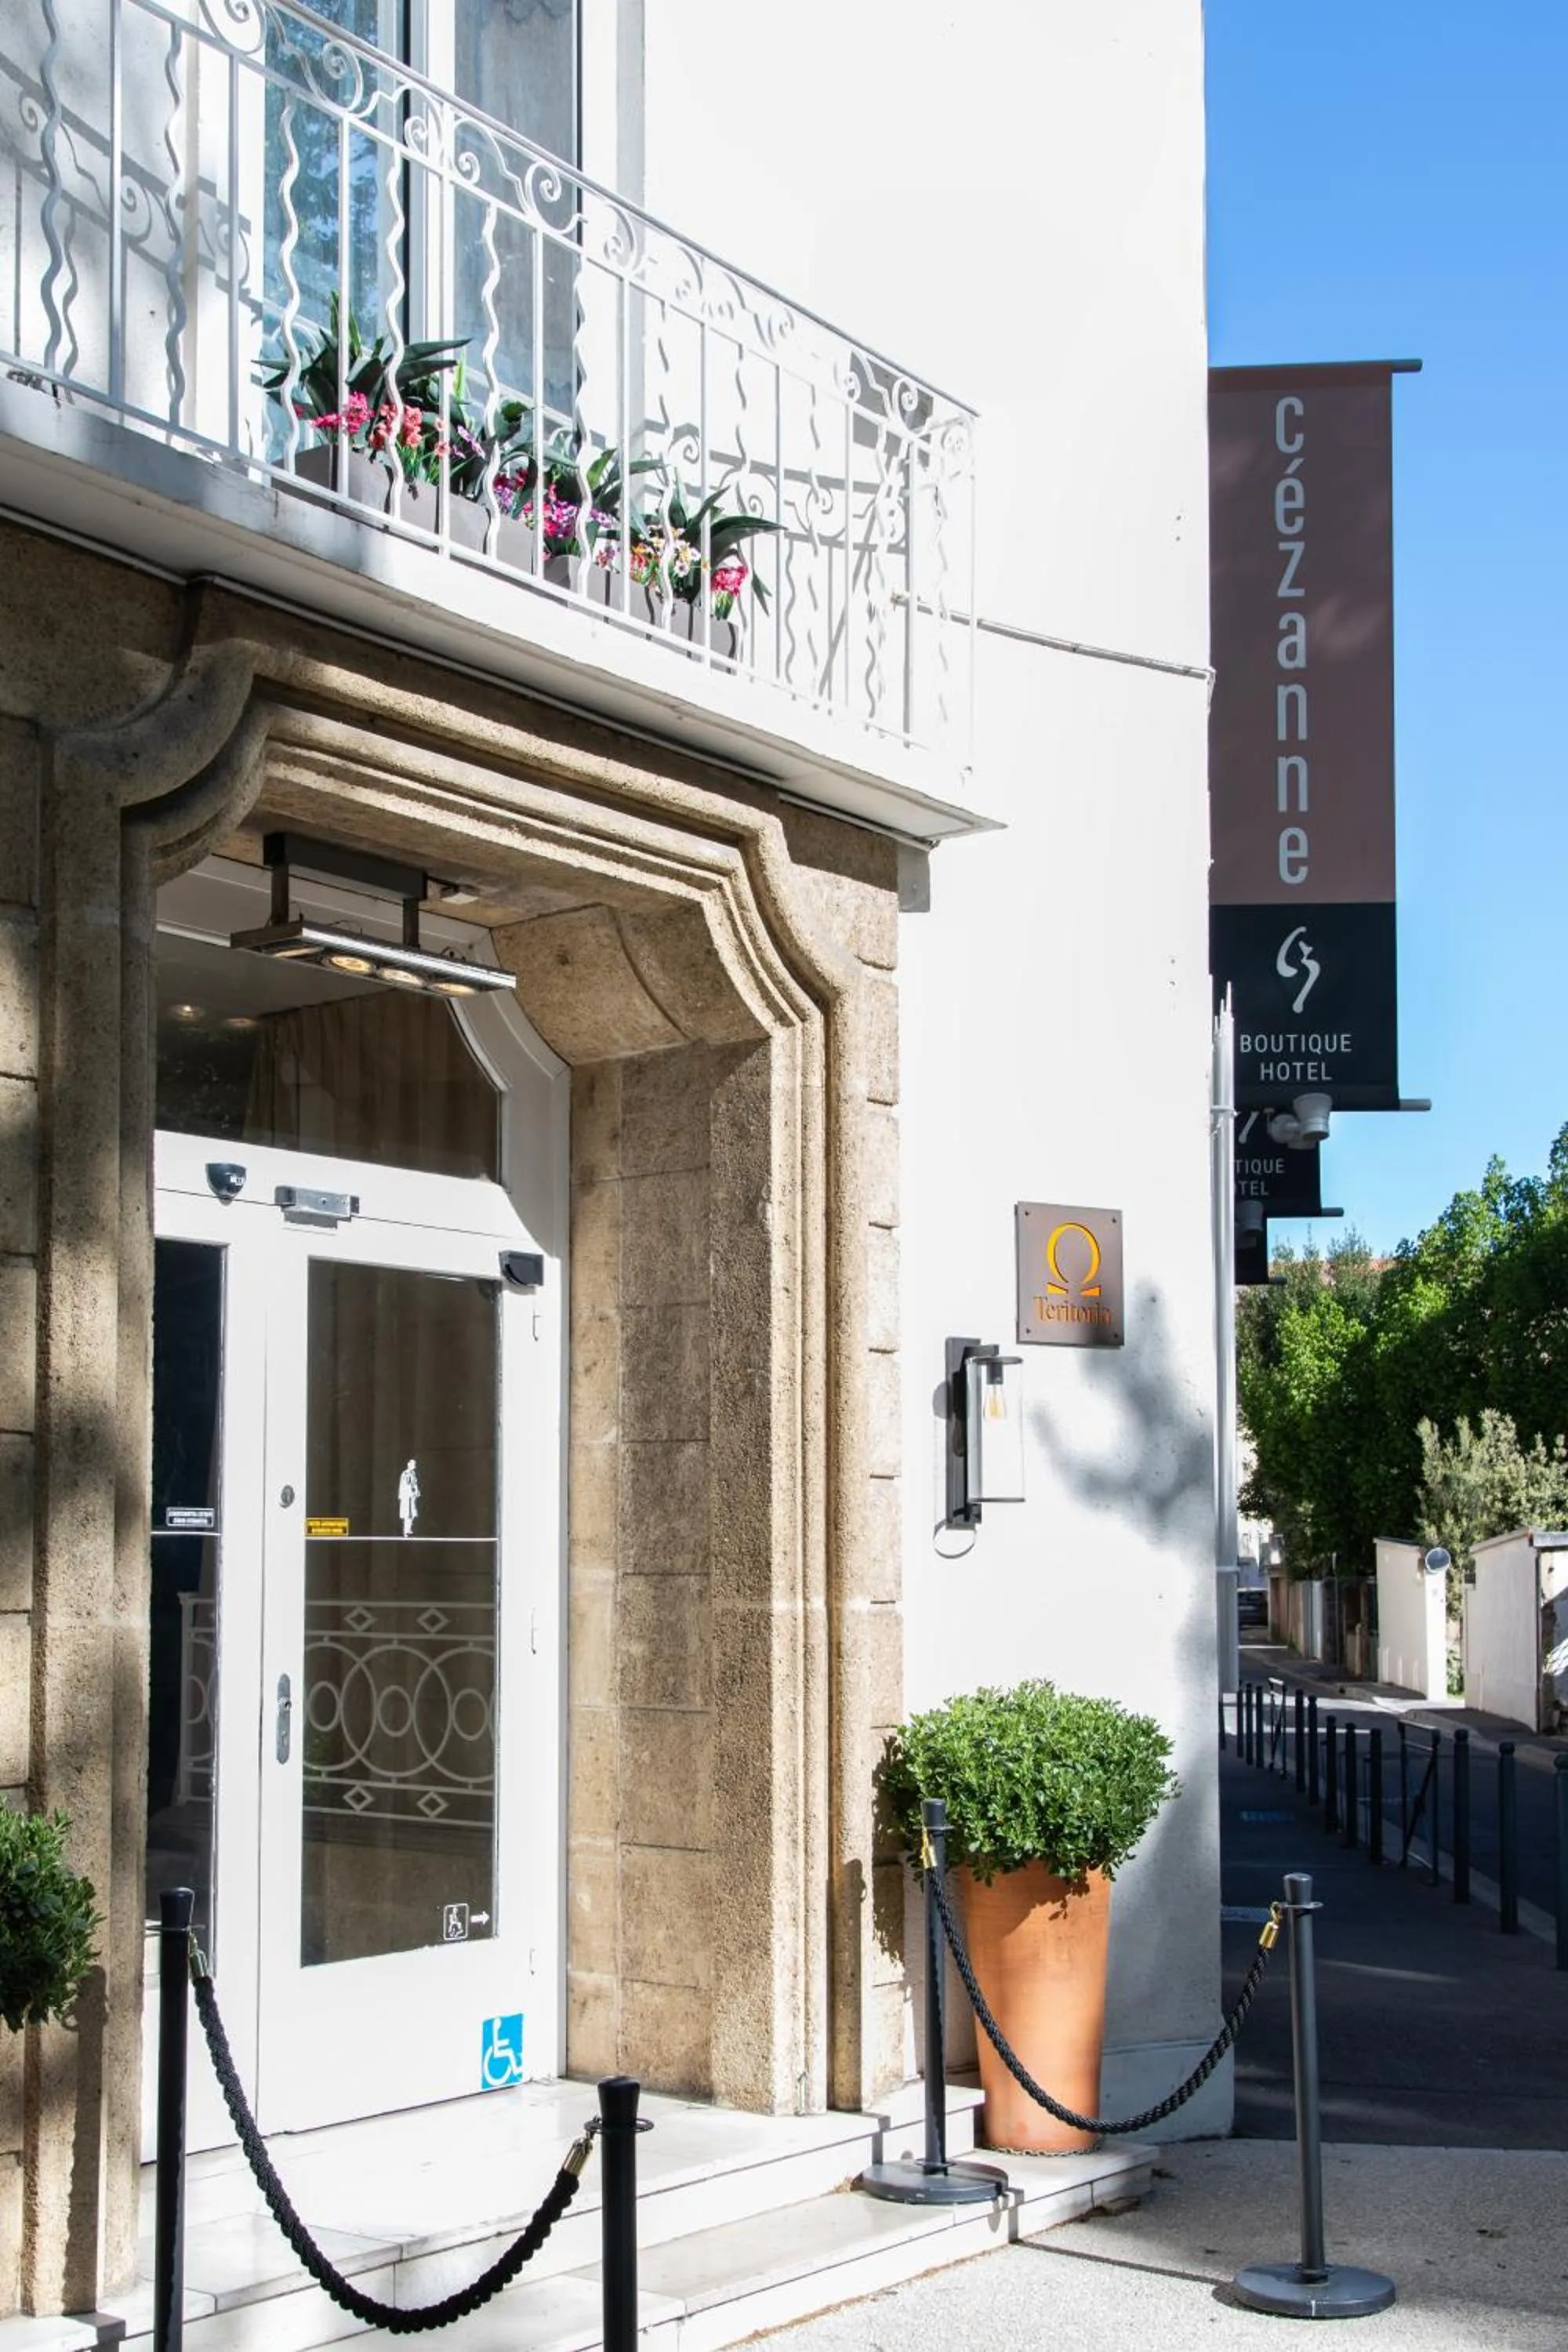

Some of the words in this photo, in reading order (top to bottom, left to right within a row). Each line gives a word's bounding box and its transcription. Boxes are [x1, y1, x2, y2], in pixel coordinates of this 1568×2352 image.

[1240, 1034, 1352, 1054] BOUTIQUE
[1260, 1062, 1332, 1080] HOTEL
[1235, 1157, 1285, 1174] TIQUE
[1235, 1180, 1269, 1196] TEL
